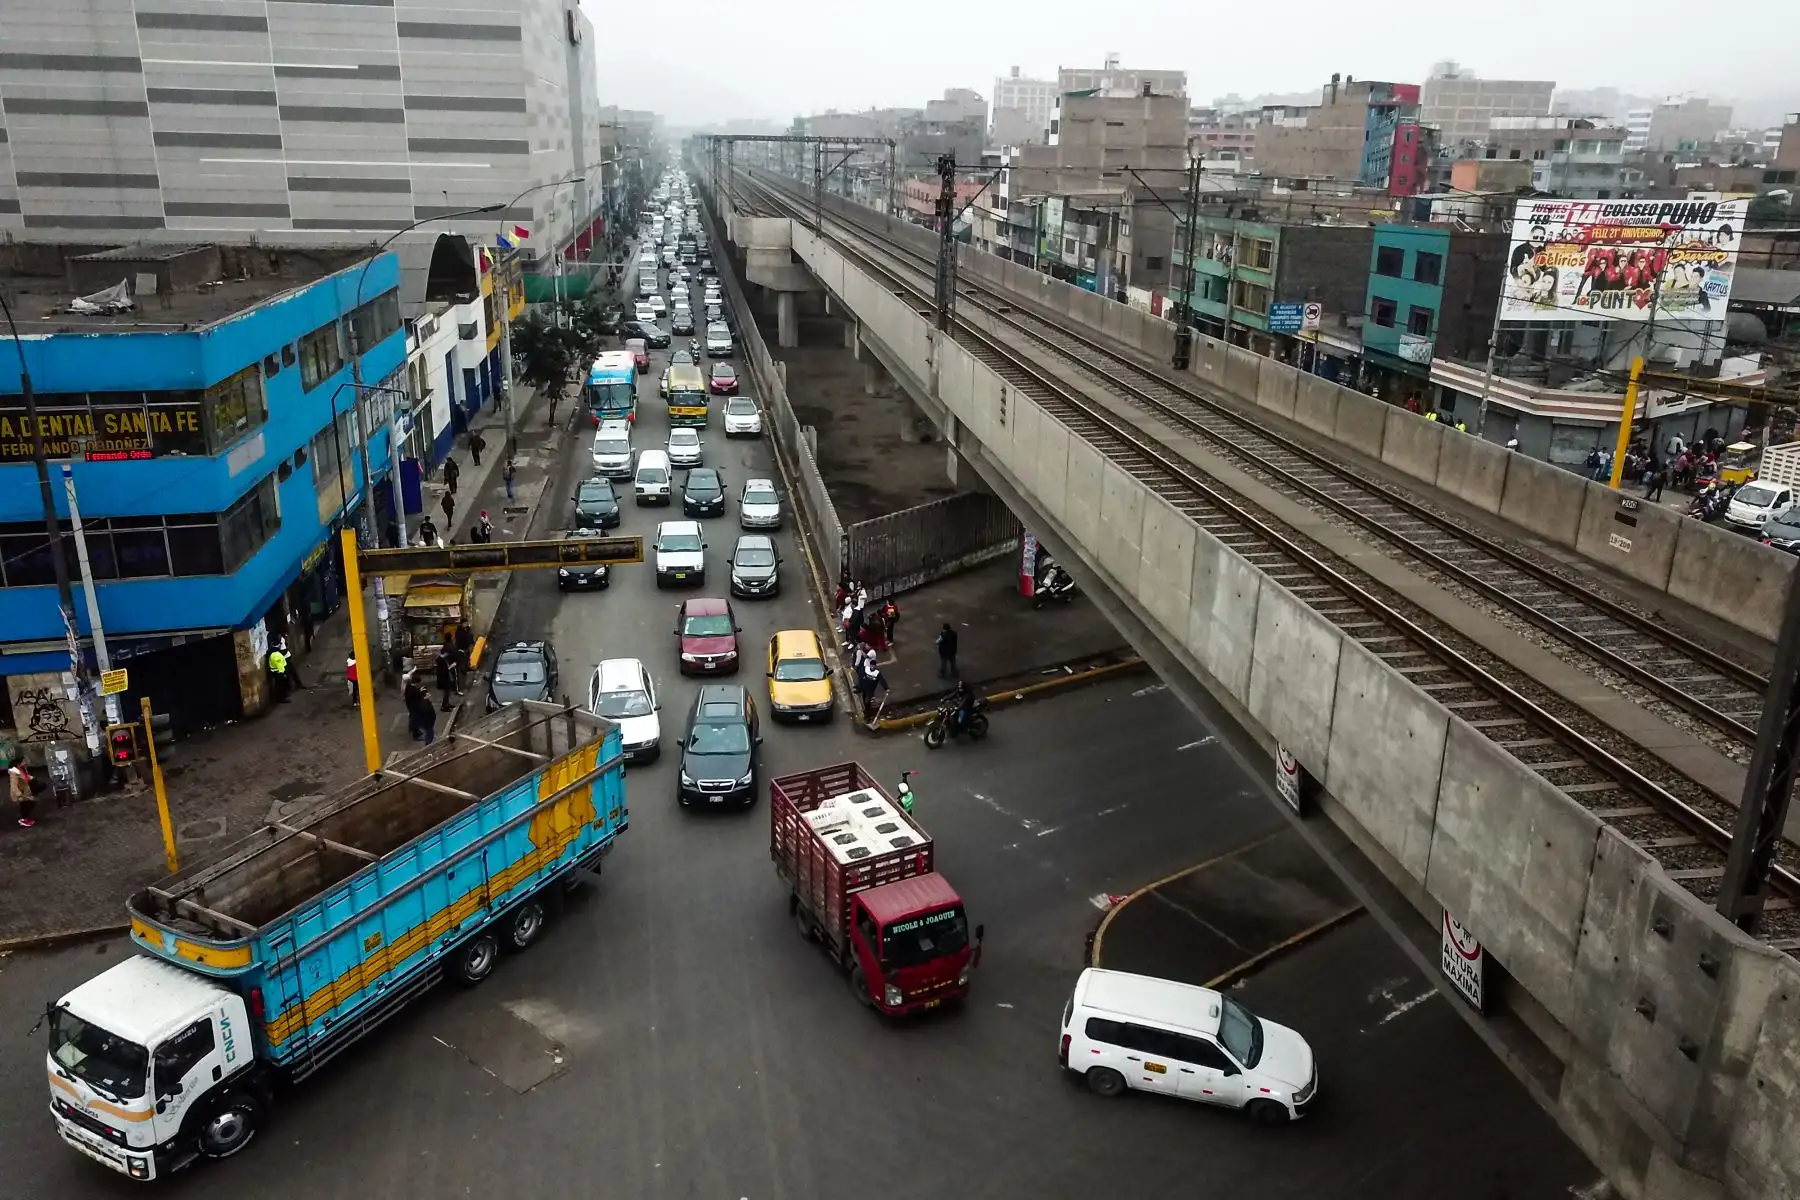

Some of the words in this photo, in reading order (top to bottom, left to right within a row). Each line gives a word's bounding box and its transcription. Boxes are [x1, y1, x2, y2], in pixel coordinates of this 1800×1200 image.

[1531, 203, 1569, 213] JUEVES
[1602, 203, 1659, 217] COLISEO
[1655, 201, 1718, 224] PUNO
[1599, 217, 1653, 226] INTERNACIONAL
[1591, 228, 1609, 239] FELIZ
[20, 414, 98, 437] DENTAL
[104, 411, 172, 434] SANTA
[175, 411, 199, 432] FE
[892, 921, 918, 934] NICOLE
[926, 910, 955, 924] JOAQUIN
[1443, 943, 1480, 988] ALTURA
[1443, 956, 1480, 1004] MAXIMA
[174, 1026, 197, 1045] ISUZU
